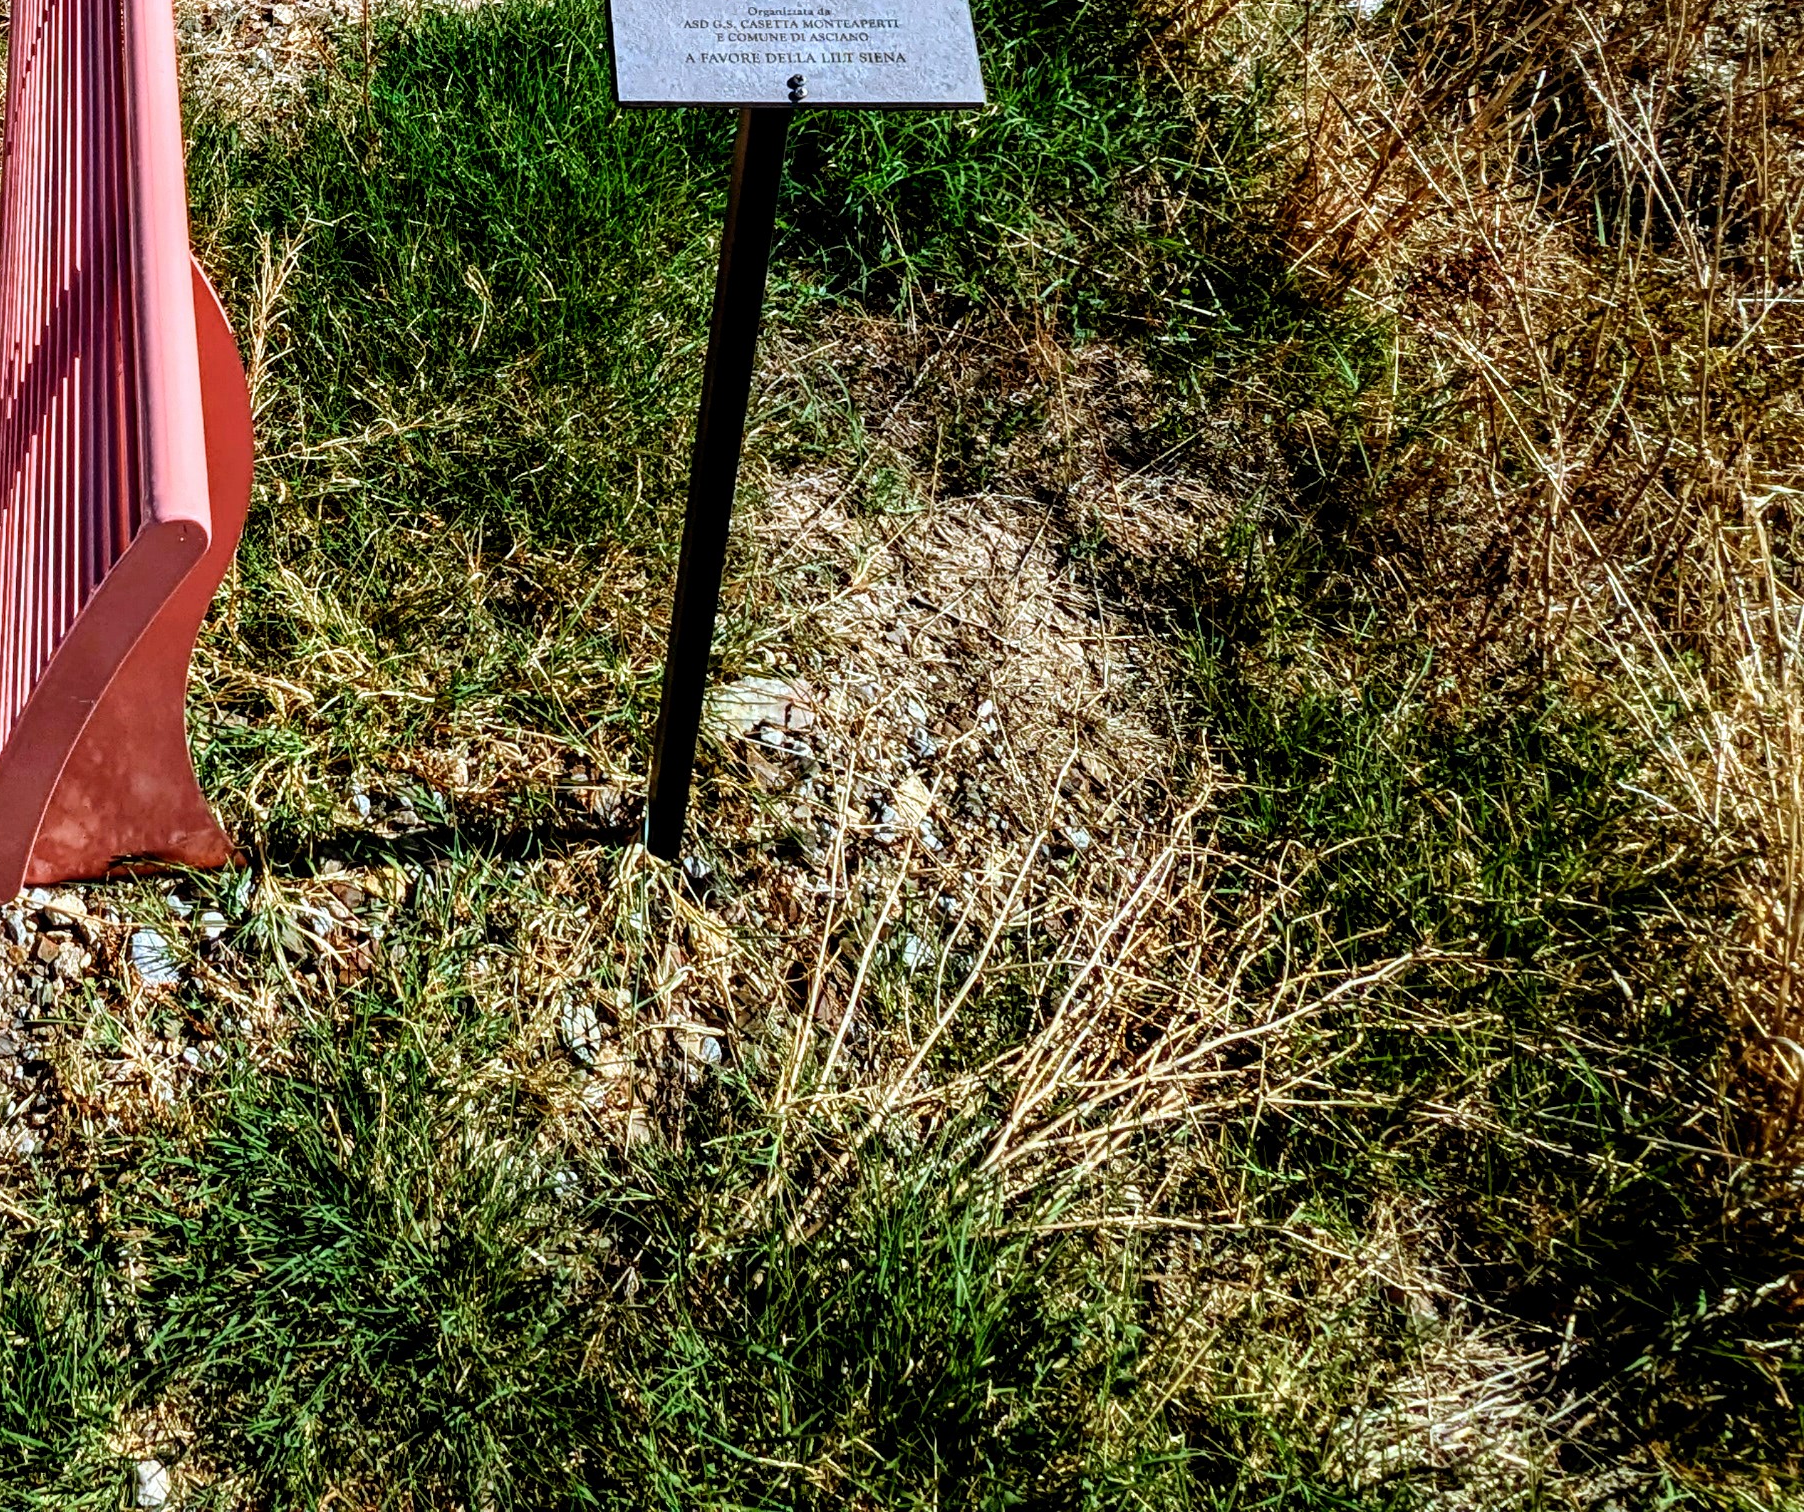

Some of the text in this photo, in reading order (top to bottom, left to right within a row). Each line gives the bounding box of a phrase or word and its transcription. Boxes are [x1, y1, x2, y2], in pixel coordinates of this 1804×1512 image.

[747, 7, 832, 17] Organizzata da
[683, 18, 900, 29] ASD G.S. CASETTA MONTEAPERTI
[716, 31, 870, 42] E COMUNE DI ASCIANO
[685, 52, 696, 64] A
[700, 52, 761, 64] FAVORE
[765, 52, 817, 64] DELLA
[858, 51, 907, 64] SIENA
